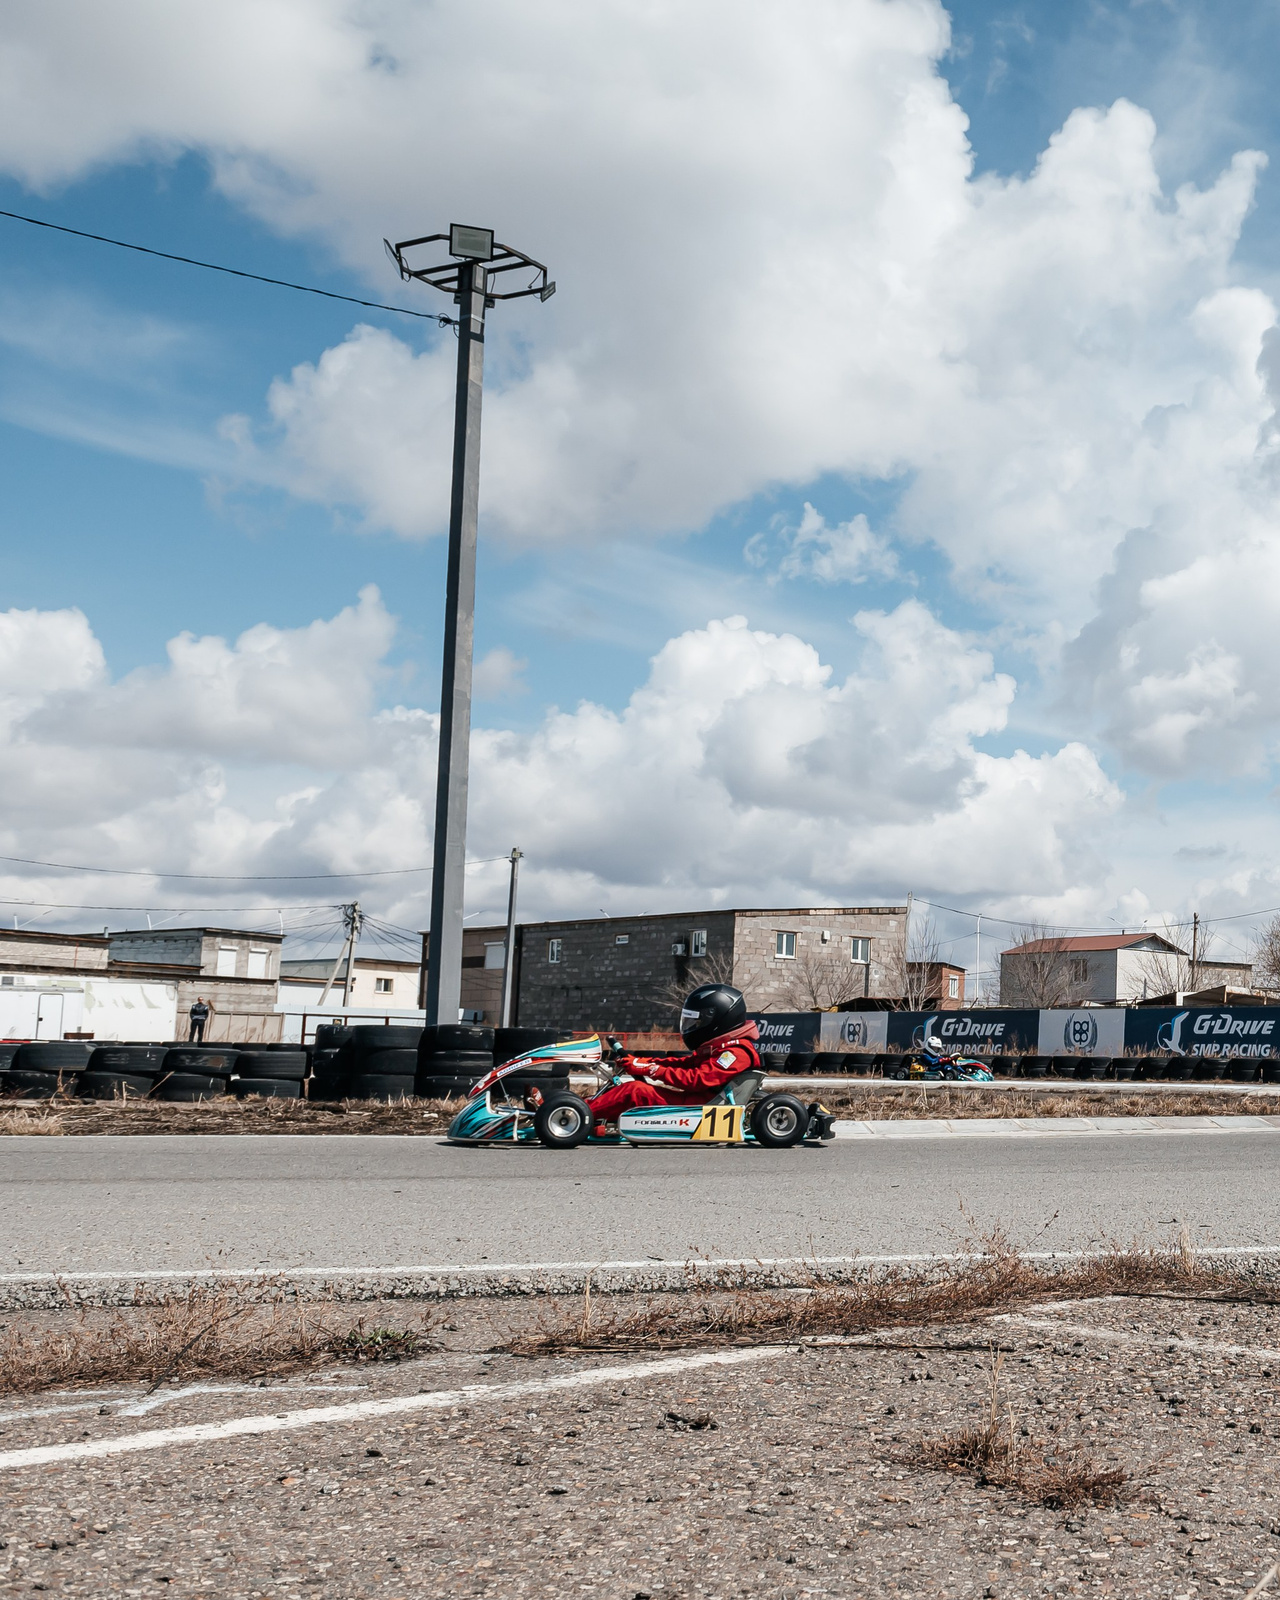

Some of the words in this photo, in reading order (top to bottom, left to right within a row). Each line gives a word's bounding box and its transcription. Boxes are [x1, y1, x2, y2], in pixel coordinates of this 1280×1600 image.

[760, 1042, 792, 1054] RACING
[963, 1043, 1003, 1055] RACING
[1192, 1043, 1221, 1056] SMP
[1221, 1043, 1271, 1057] RACING
[678, 1118, 690, 1126] K
[704, 1107, 735, 1138] 11
